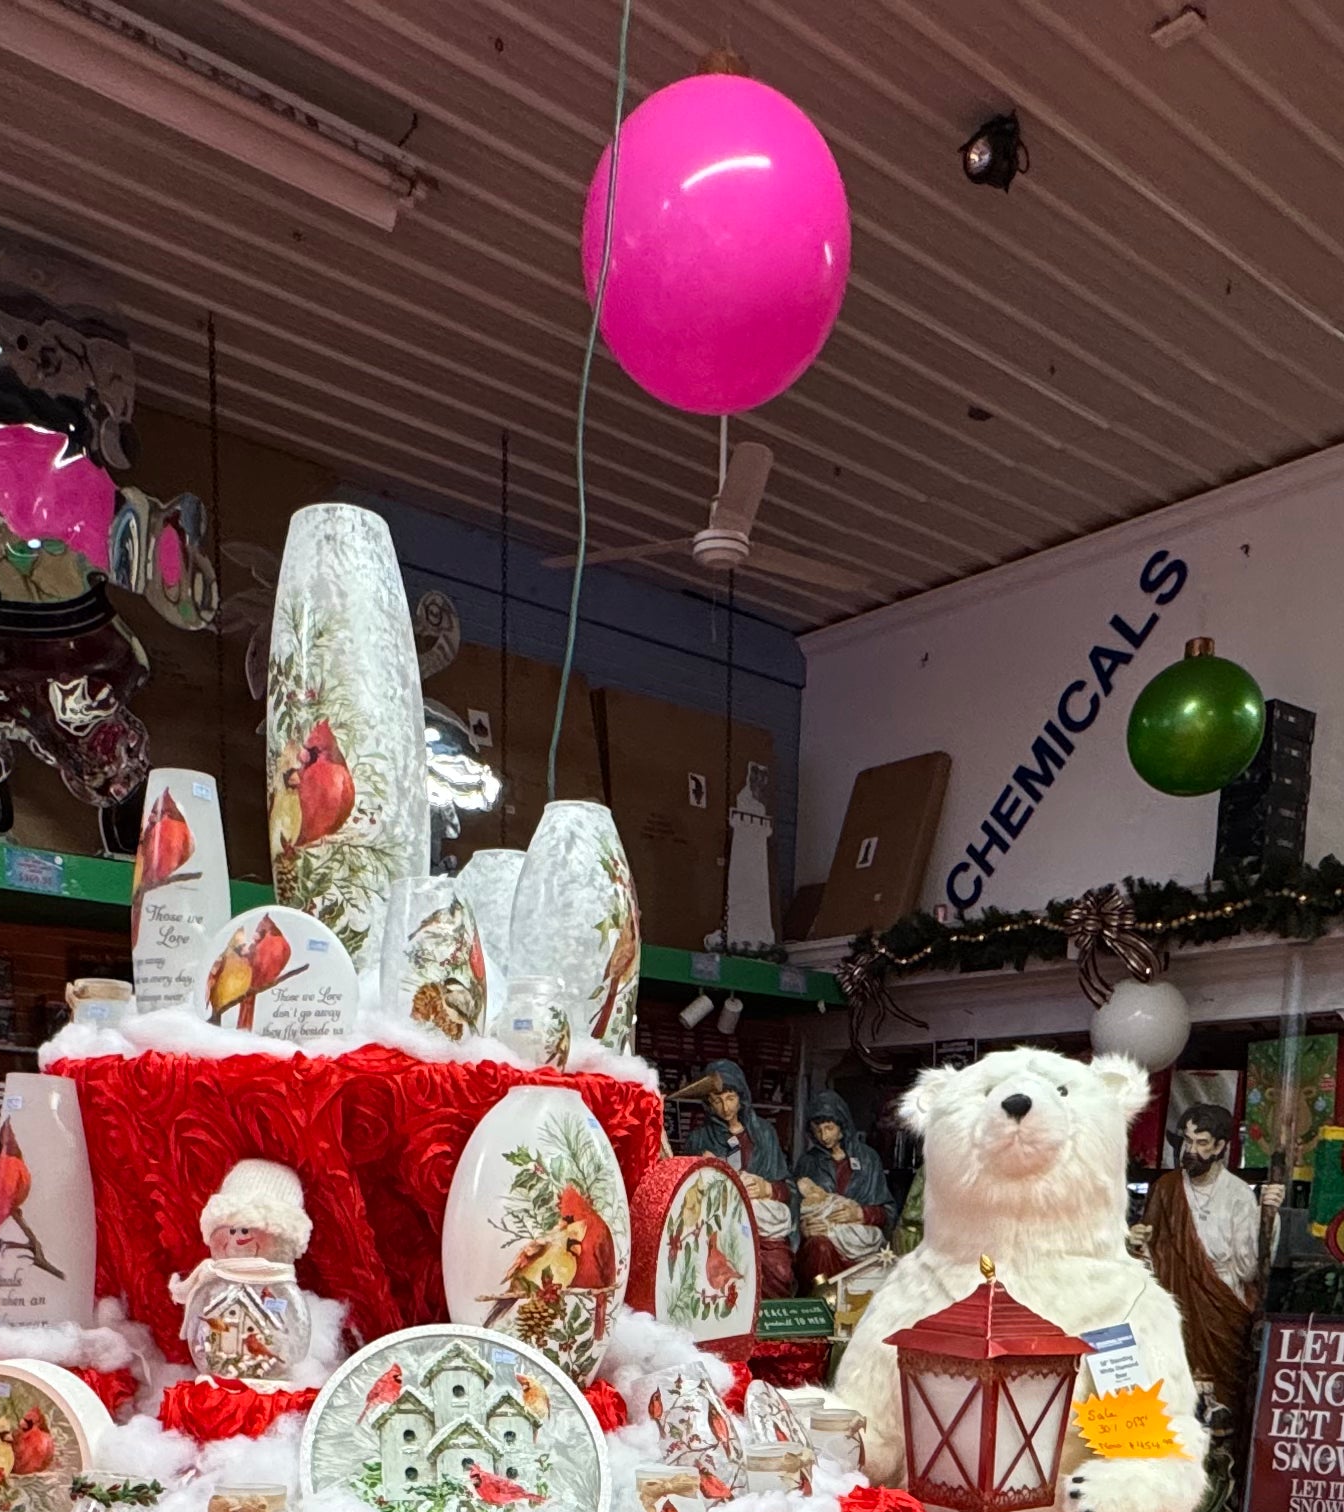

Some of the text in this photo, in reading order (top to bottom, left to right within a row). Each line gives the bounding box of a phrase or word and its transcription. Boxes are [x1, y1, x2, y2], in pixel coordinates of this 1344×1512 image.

[946, 550, 1188, 909] CHEMICALS
[145, 904, 183, 921] Those
[156, 926, 190, 948] Love
[1268, 1408, 1330, 1440] LET
[1292, 1479, 1326, 1499] LET
